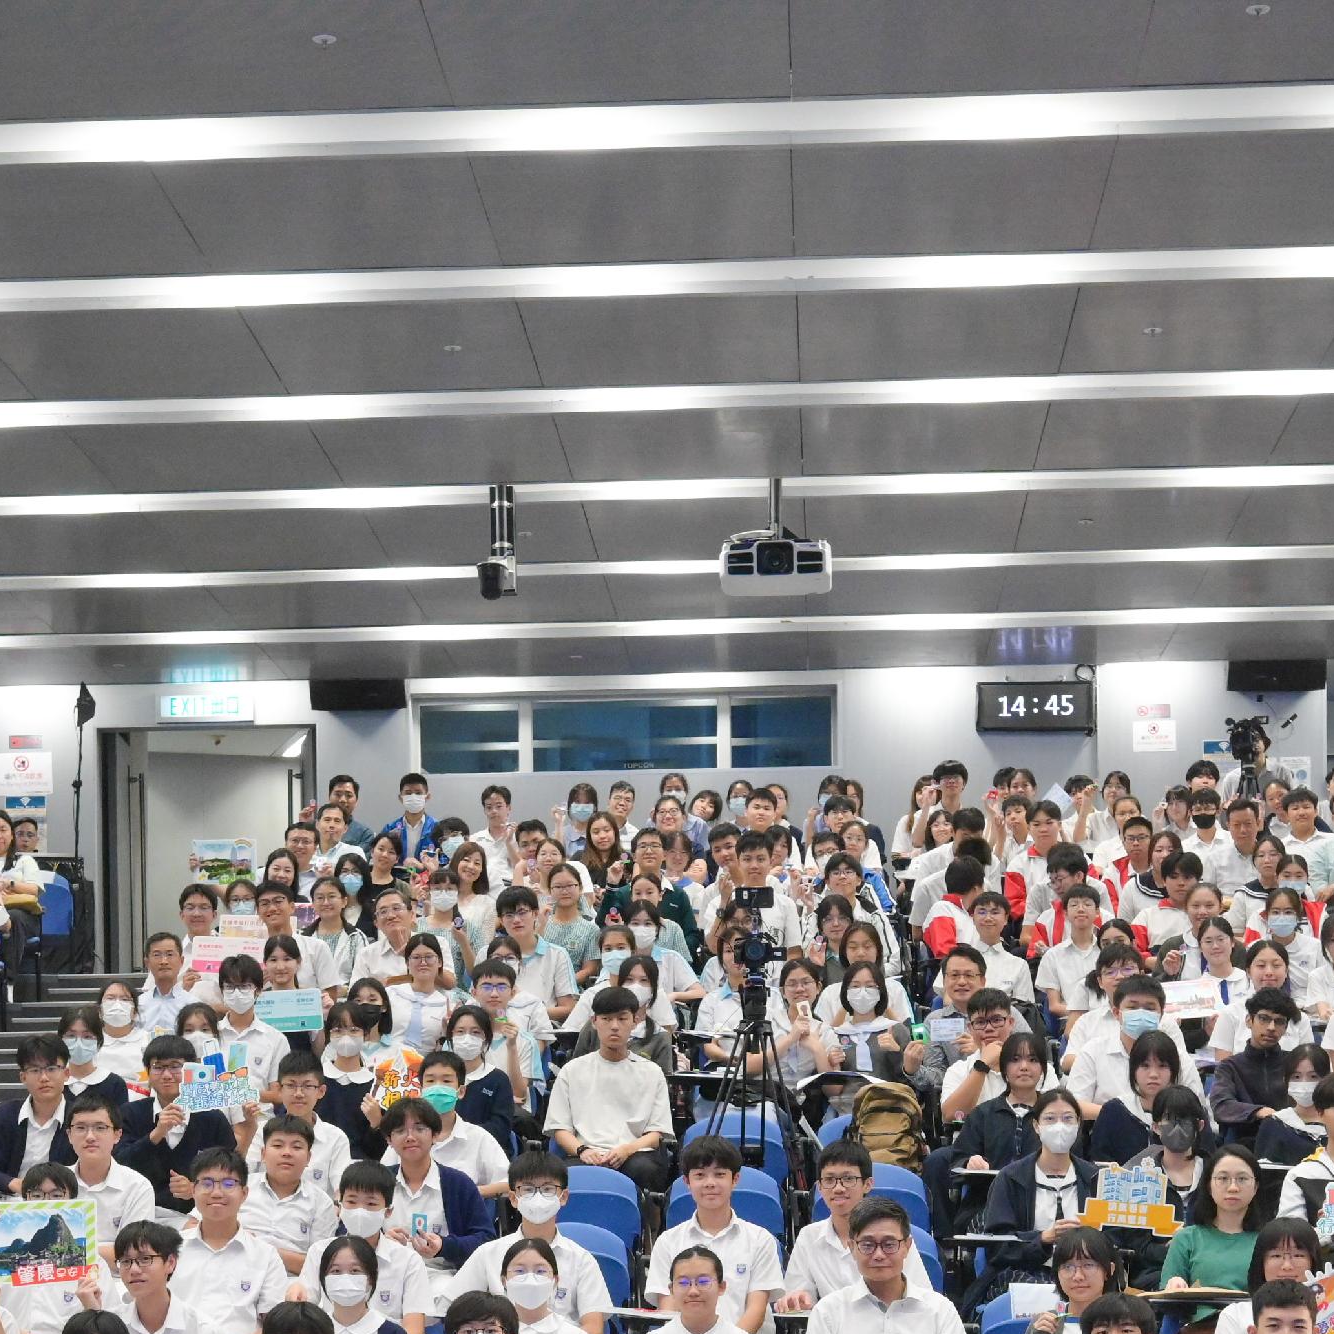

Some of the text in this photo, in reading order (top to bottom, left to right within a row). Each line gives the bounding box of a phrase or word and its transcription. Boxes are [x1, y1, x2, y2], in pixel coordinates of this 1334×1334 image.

[170, 696, 239, 715] EXIT 出口
[998, 695, 1074, 716] 14:45
[381, 1068, 421, 1089] 薪火
